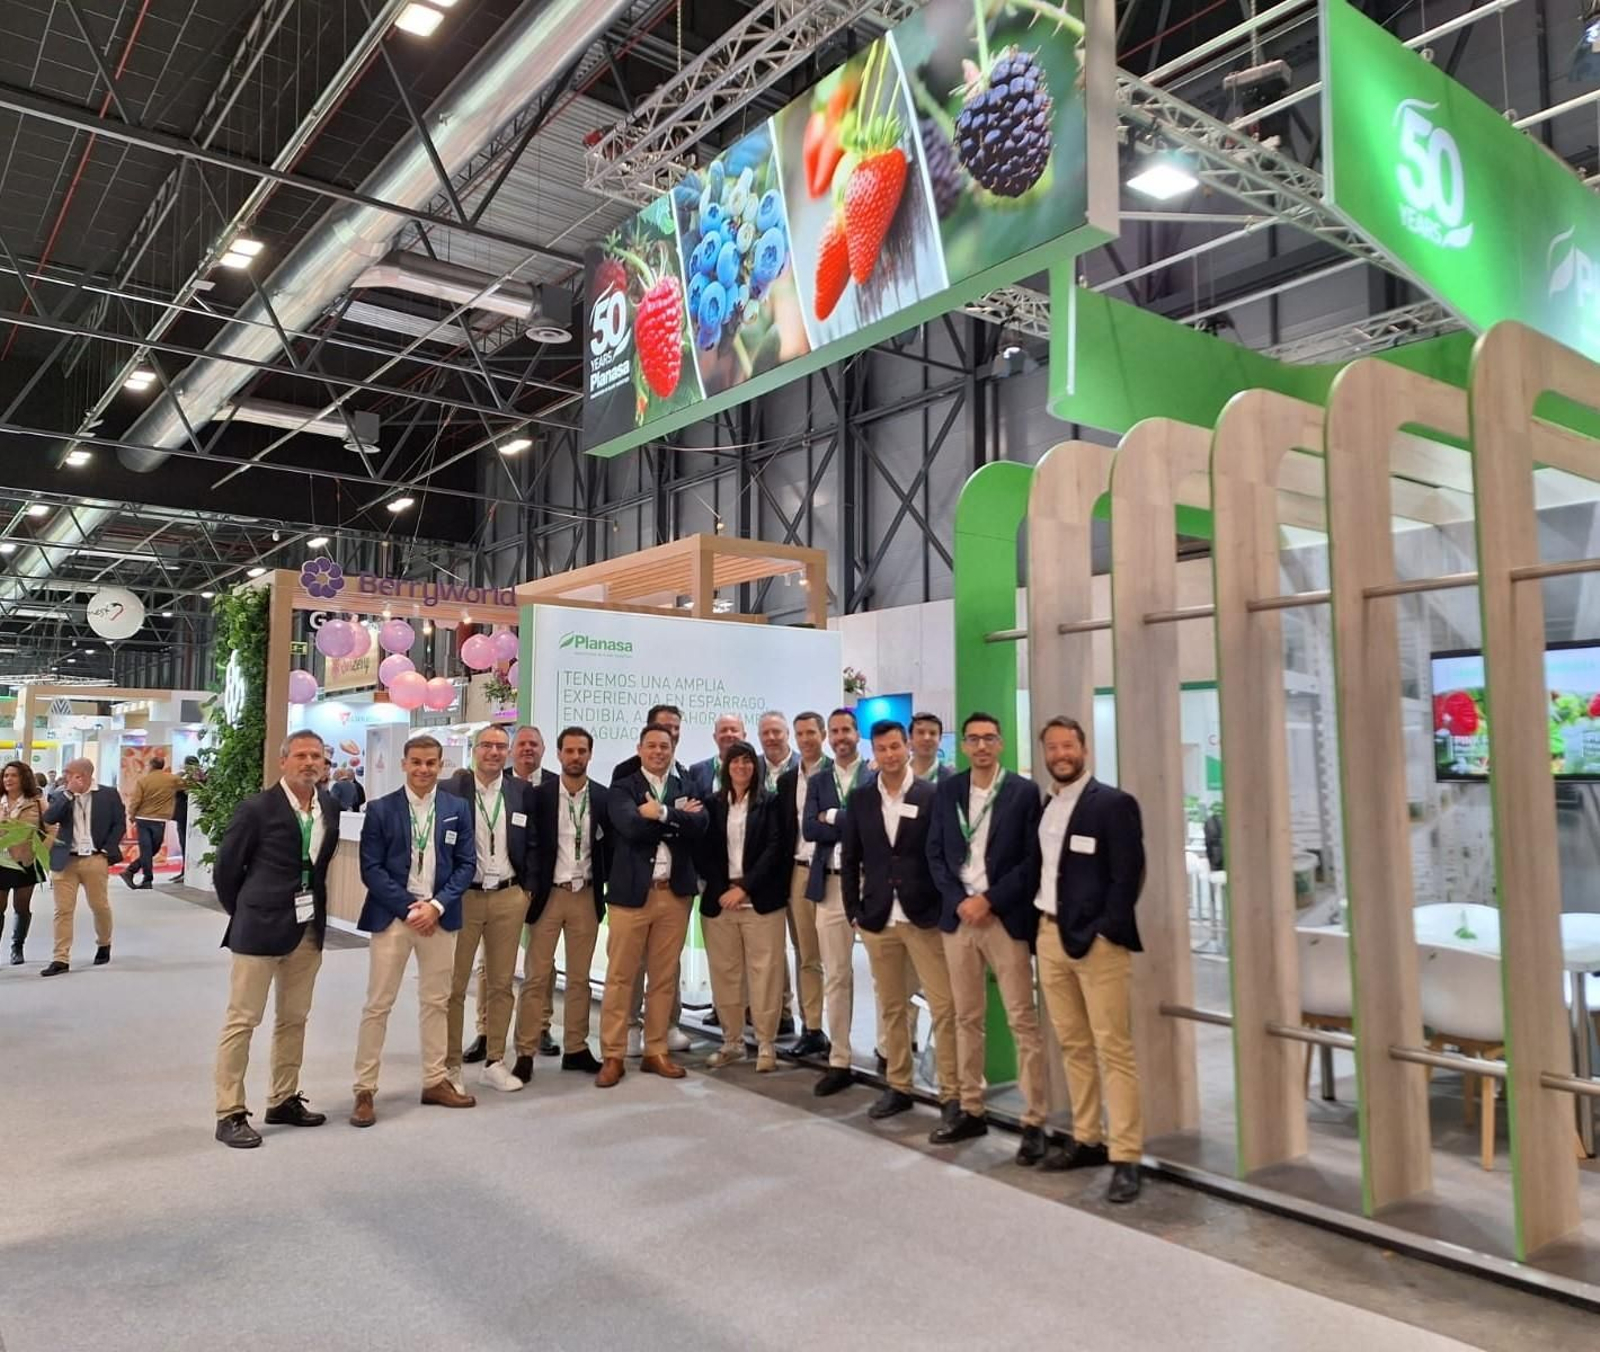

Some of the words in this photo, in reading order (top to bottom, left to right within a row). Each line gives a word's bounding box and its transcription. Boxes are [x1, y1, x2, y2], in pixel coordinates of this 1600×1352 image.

[1397, 106, 1465, 228] 50
[590, 290, 626, 356] 50
[590, 350, 614, 372] YEARS
[590, 360, 630, 393] Planasa
[359, 571, 517, 607] BerryWorld
[575, 635, 633, 652] Planasa
[564, 670, 636, 688] TENEMOS
[641, 676, 671, 690] UNA
[674, 677, 725, 693] AMPLIA
[563, 689, 660, 706] EXPERIENCIA
[666, 693, 684, 708] EN
